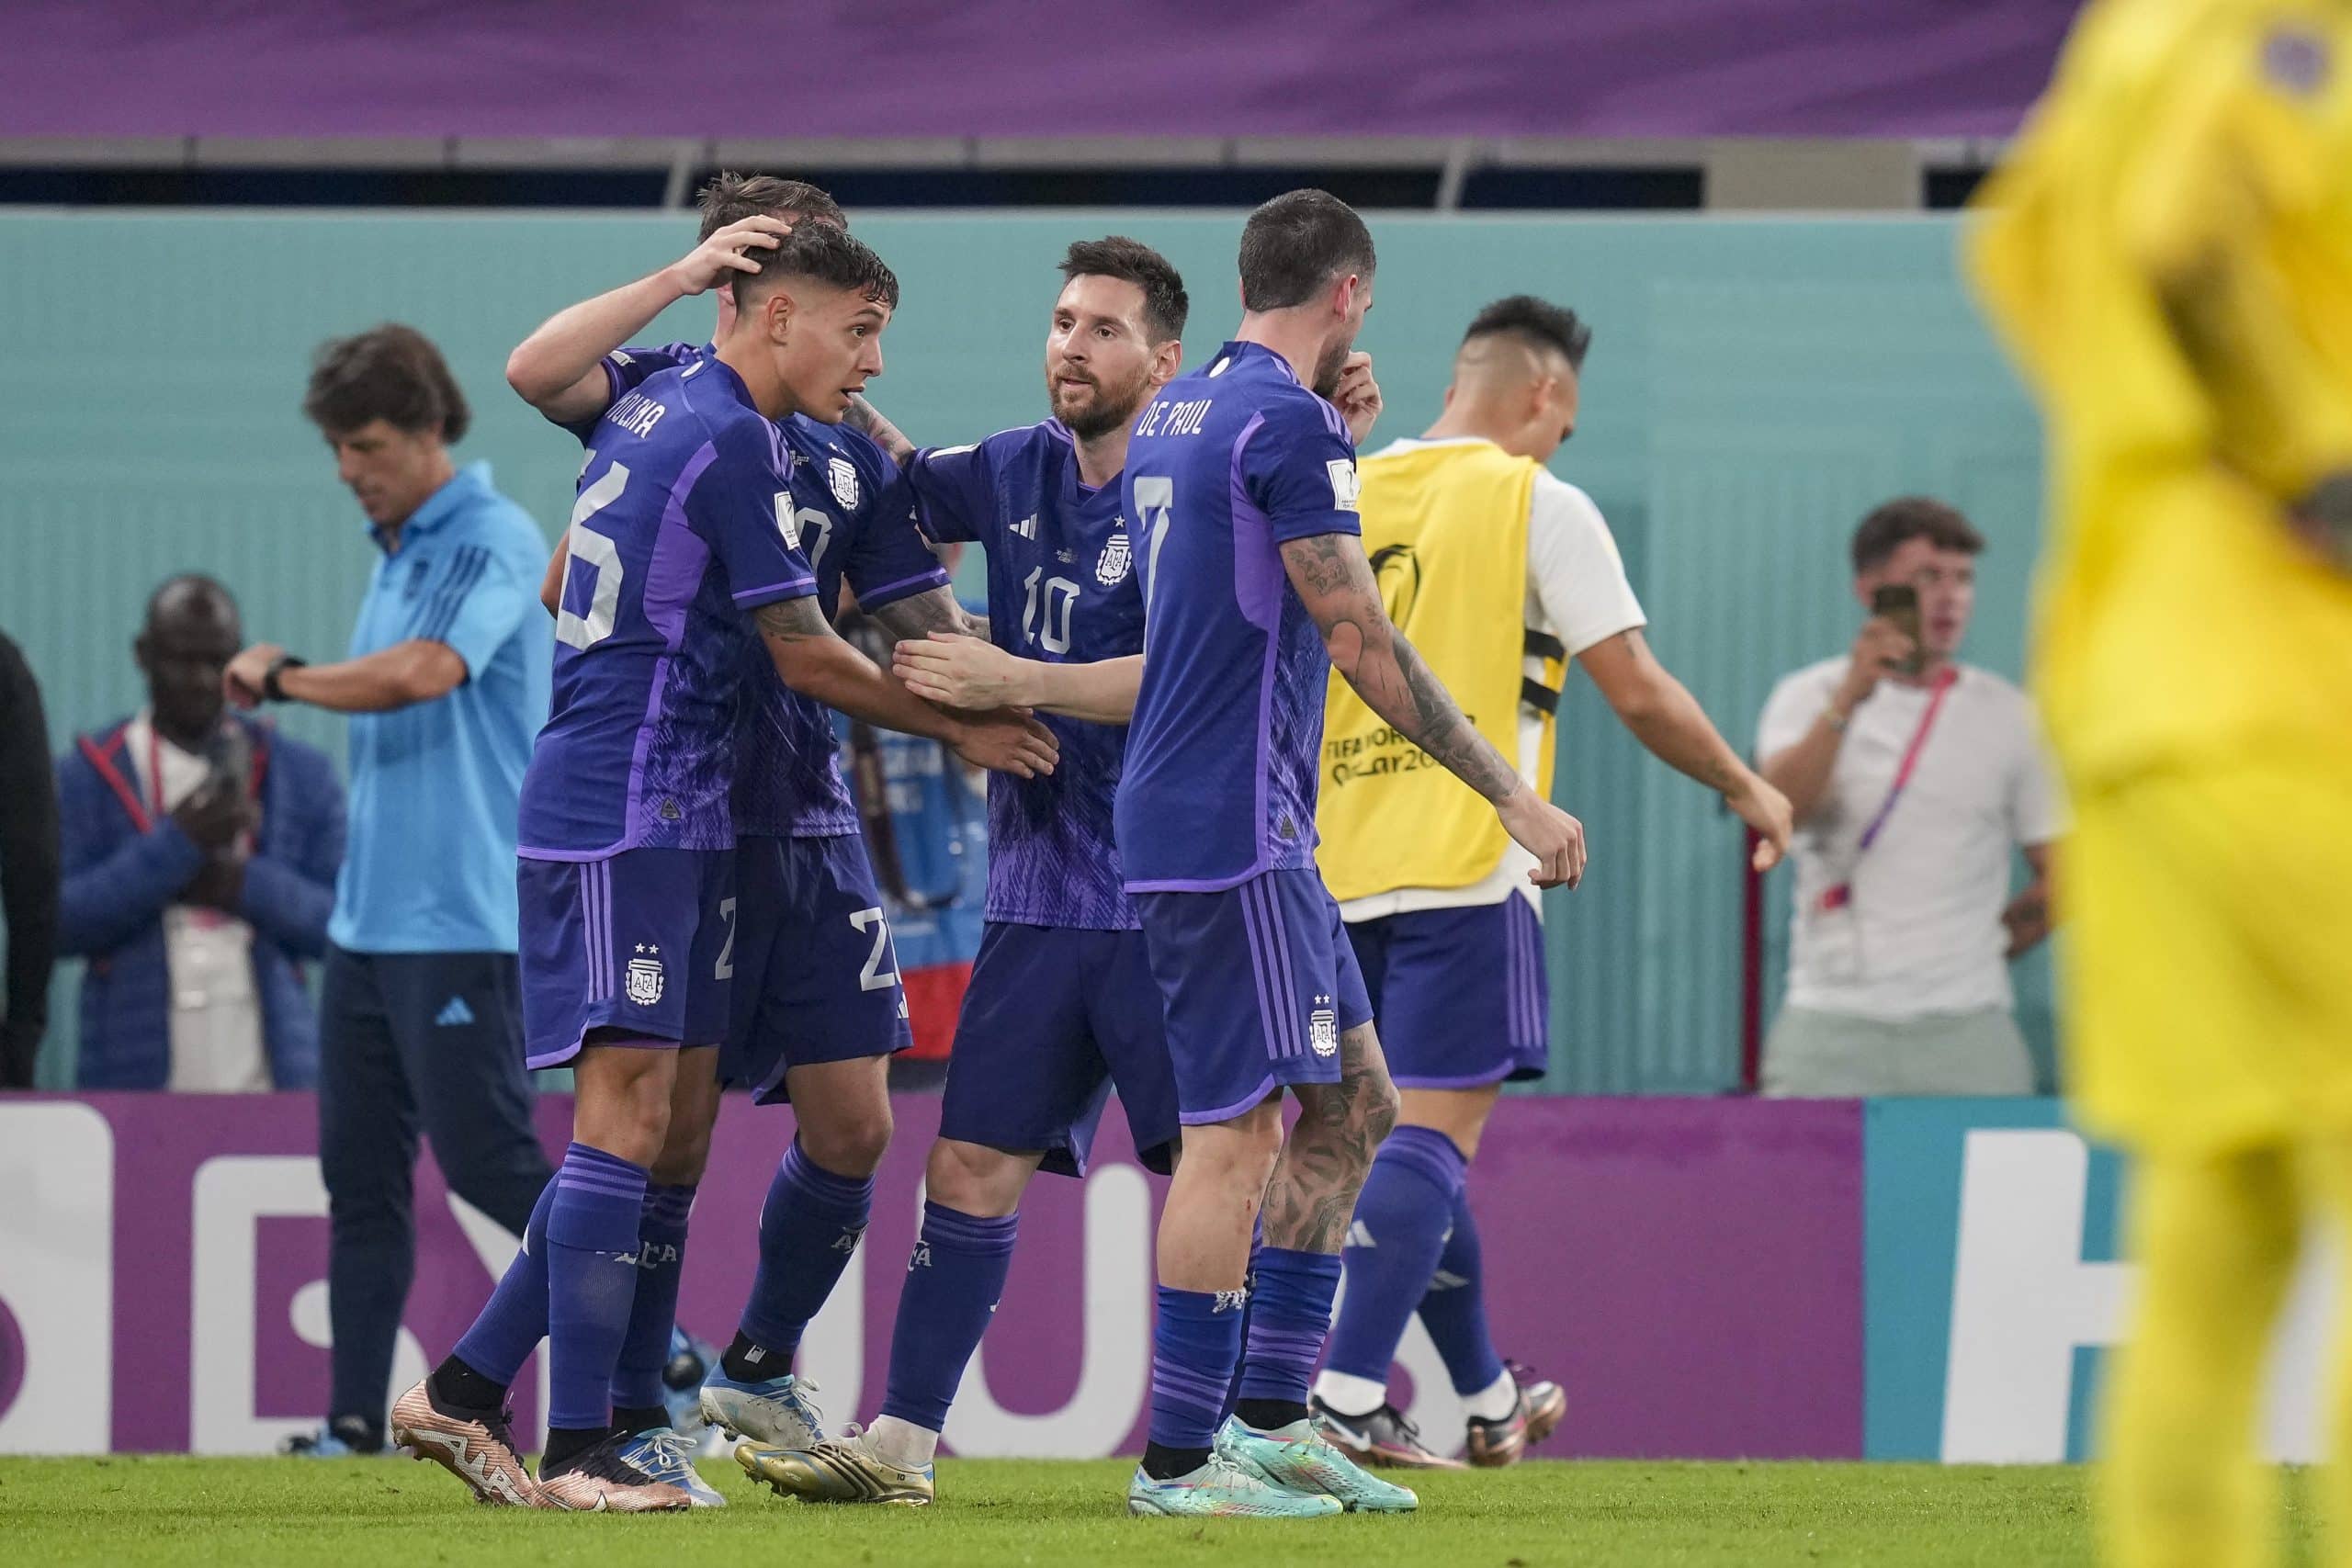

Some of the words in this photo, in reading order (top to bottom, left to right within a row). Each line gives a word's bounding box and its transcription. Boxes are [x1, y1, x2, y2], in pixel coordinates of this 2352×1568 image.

[1136, 400, 1170, 436] DE
[1160, 399, 1213, 436] PAUL
[555, 447, 631, 651] 6
[1022, 565, 1080, 655] 10
[1133, 476, 1174, 669] 7
